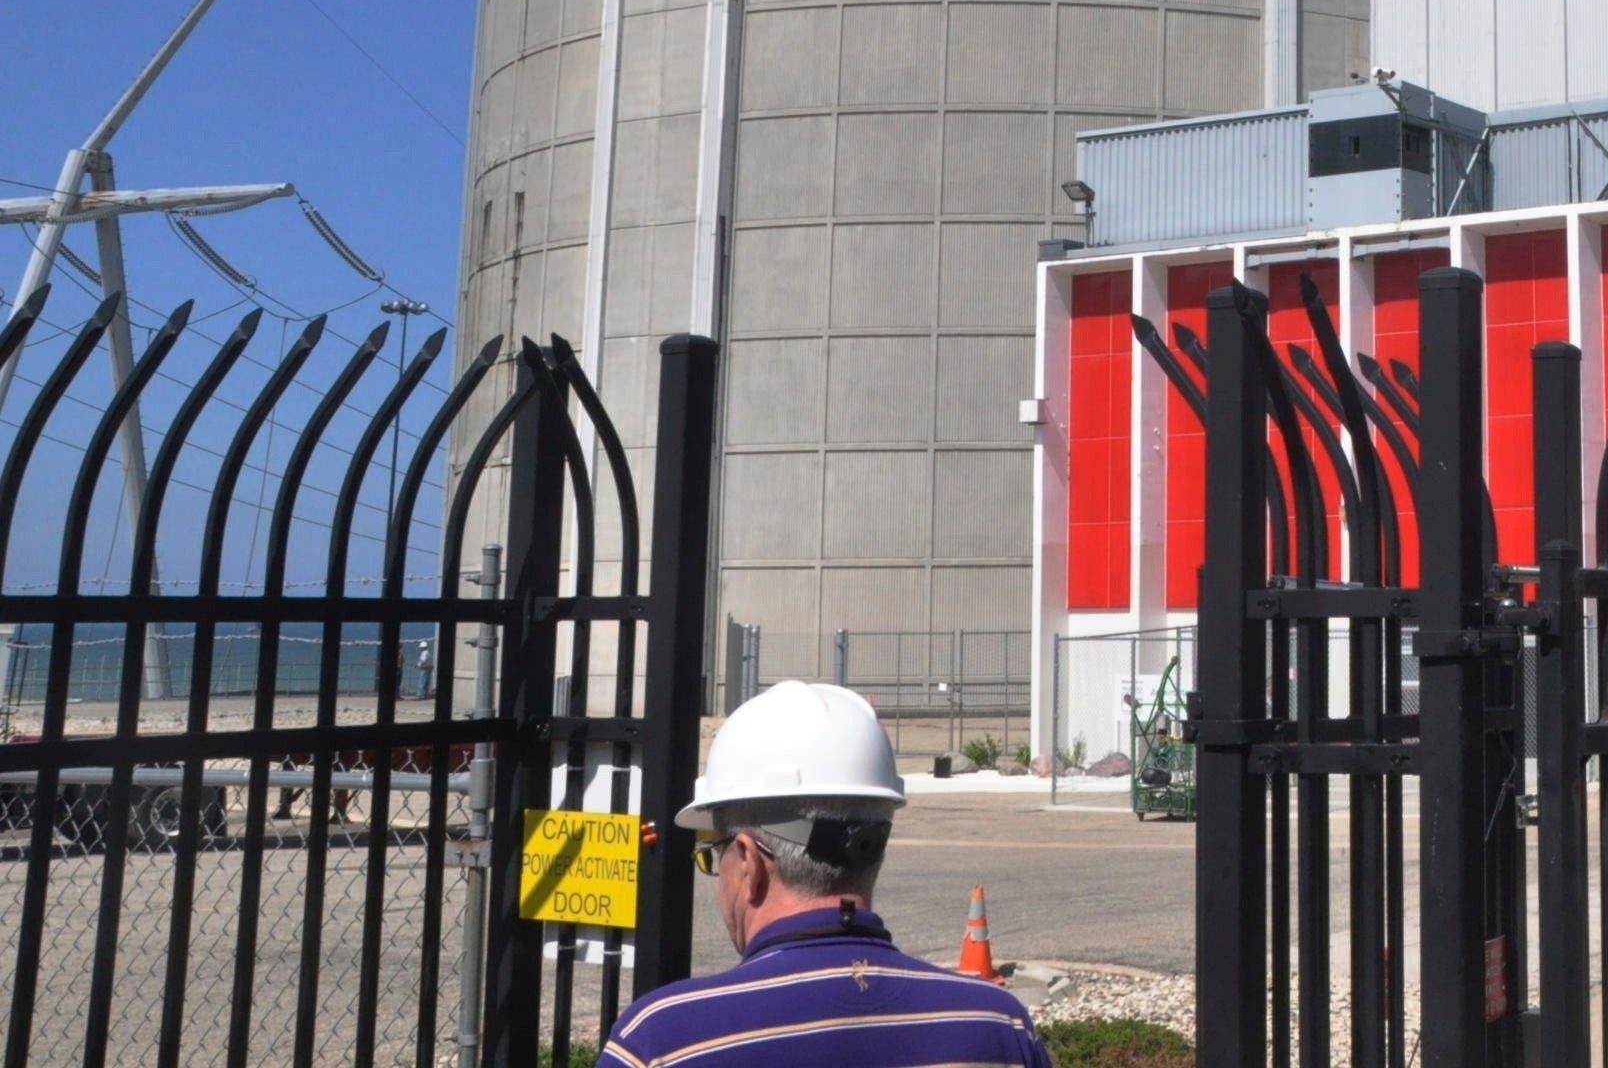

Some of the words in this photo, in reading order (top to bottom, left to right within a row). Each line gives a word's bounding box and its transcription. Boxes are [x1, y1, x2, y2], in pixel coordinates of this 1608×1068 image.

[542, 818, 630, 844] CAUTION
[522, 853, 573, 877] POWER
[575, 857, 636, 882] ACTIVATE
[553, 891, 612, 917] DOOR
